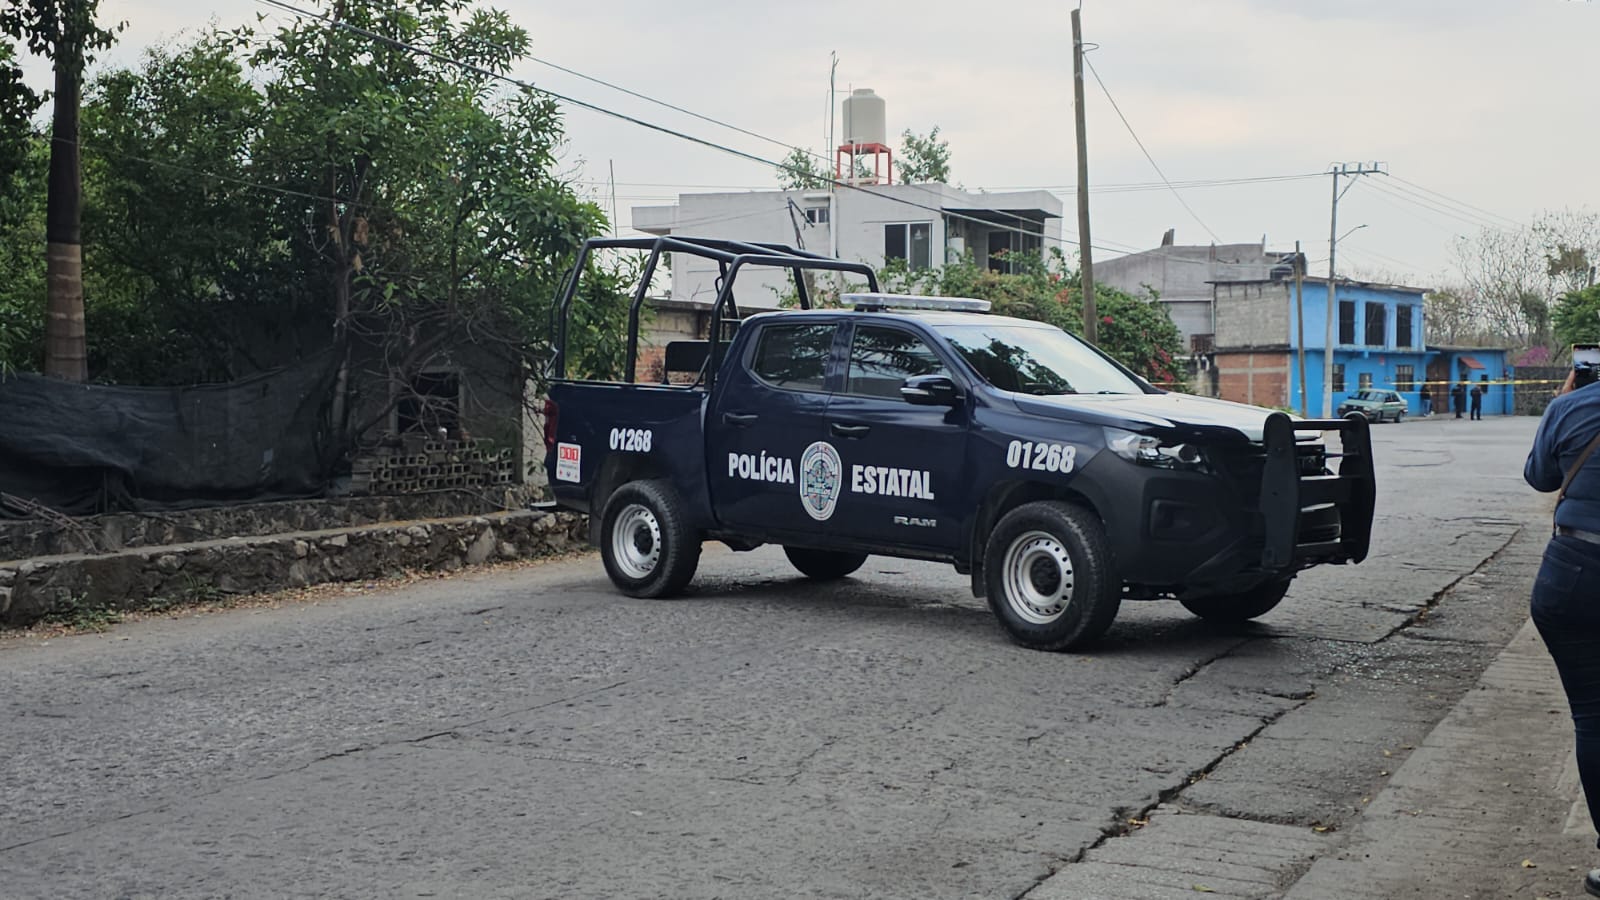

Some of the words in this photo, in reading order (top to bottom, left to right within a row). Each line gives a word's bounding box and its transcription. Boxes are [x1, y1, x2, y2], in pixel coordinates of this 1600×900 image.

[609, 428, 652, 452] 01268
[1006, 440, 1076, 473] 01268
[729, 451, 795, 484] POLÍCIA
[852, 465, 935, 500] ESTATAL
[894, 515, 937, 527] RAM
